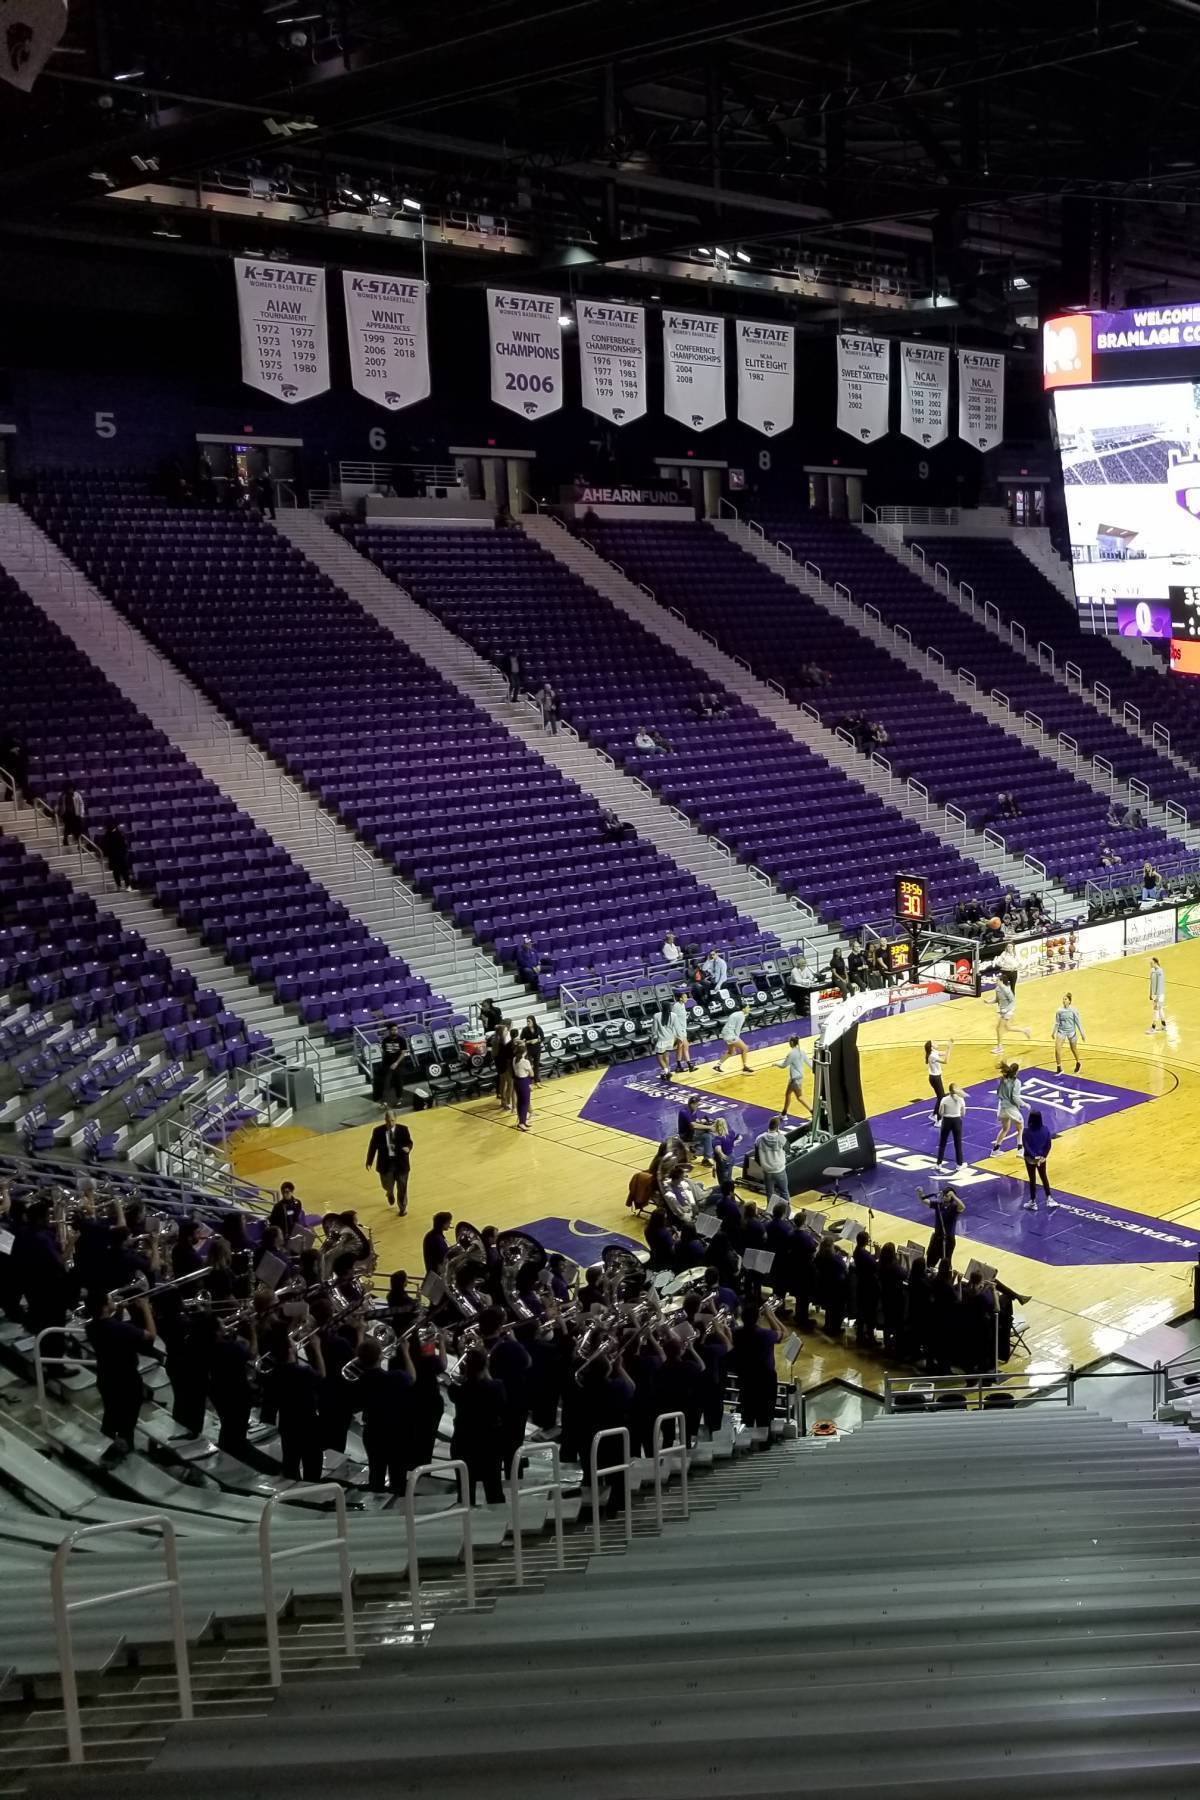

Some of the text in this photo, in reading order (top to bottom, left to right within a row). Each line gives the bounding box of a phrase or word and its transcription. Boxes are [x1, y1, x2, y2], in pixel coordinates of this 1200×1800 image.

[244, 266, 318, 286] K-STATE
[250, 280, 313, 292] WOMEN'S BASKETBALL
[352, 278, 418, 298] K-STATE
[267, 300, 301, 314] AIAW
[495, 296, 554, 313] K-STATE
[261, 311, 307, 321] TOURNAMENT
[372, 310, 404, 324] WNIT
[584, 306, 638, 323] K-STATE
[1134, 307, 1200, 327] WELCOME
[256, 324, 313, 337] 1972 1977
[366, 322, 410, 331] APPEARANCES
[669, 317, 719, 333] K-STATE
[364, 334, 414, 346] 1999 2015
[513, 331, 540, 343] WNIT
[592, 335, 635, 345] CONFERENCE
[742, 326, 789, 341] K-STATE
[1097, 326, 1180, 349] BRAMLAGE
[257, 336, 314, 349] 1973 1978
[586, 342, 642, 354] CHAMPIONSHIPS
[675, 344, 715, 354] CONFERENCE
[841, 338, 885, 354] K-STATE
[259, 348, 316, 360] 1974 1979
[365, 346, 415, 357] 2006 2018
[496, 342, 559, 360] CHAMPIONS
[670, 351, 721, 363] CHAMPIONSHIPS
[906, 348, 944, 361] K-STATE
[260, 360, 316, 373] 1975 1980
[365, 357, 386, 366] 2007
[593, 356, 636, 368] 1976 1982
[745, 358, 787, 371] ELITE EIGHT
[964, 355, 1000, 368] K-STATE
[366, 369, 387, 378] 2013
[620, 370, 636, 378] 1983
[676, 365, 692, 373] 2004
[842, 369, 888, 381] SWEET SIXTEEN
[260, 372, 283, 381] 1976
[505, 372, 554, 393] 2006
[595, 378, 637, 388] 1978 1984
[749, 373, 764, 381] 1982
[916, 372, 936, 382] NCAA
[972, 379, 991, 388] NCAA
[596, 388, 638, 399] 1979 1987
[95, 412, 116, 438] 5
[369, 427, 386, 451] 6
[758, 450, 771, 470] 8
[918, 462, 929, 479] 9
[1136, 602, 1151, 634] 0
[904, 895, 920, 914] 30
